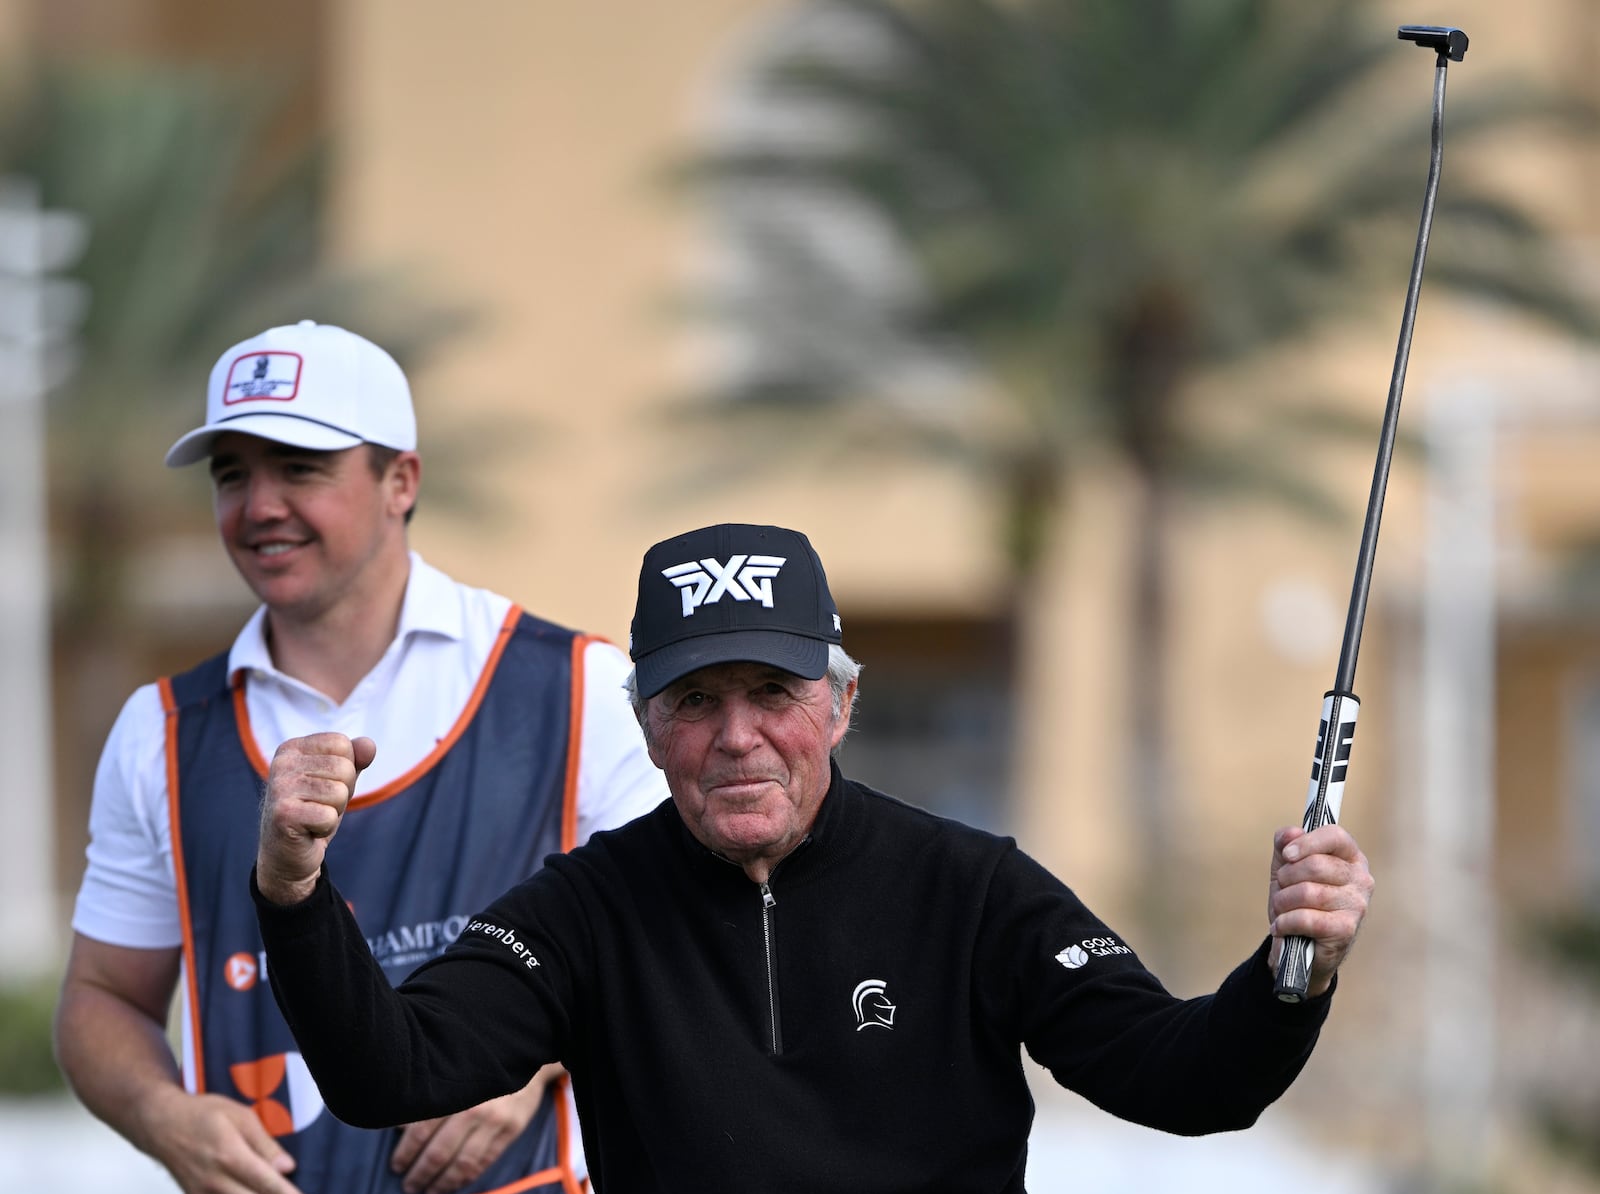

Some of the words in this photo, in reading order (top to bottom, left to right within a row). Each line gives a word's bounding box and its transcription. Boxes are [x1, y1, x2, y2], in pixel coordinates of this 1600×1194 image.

[661, 555, 787, 618] PXG
[1081, 937, 1115, 949] GOLF
[1091, 946, 1132, 957] SAUDI
